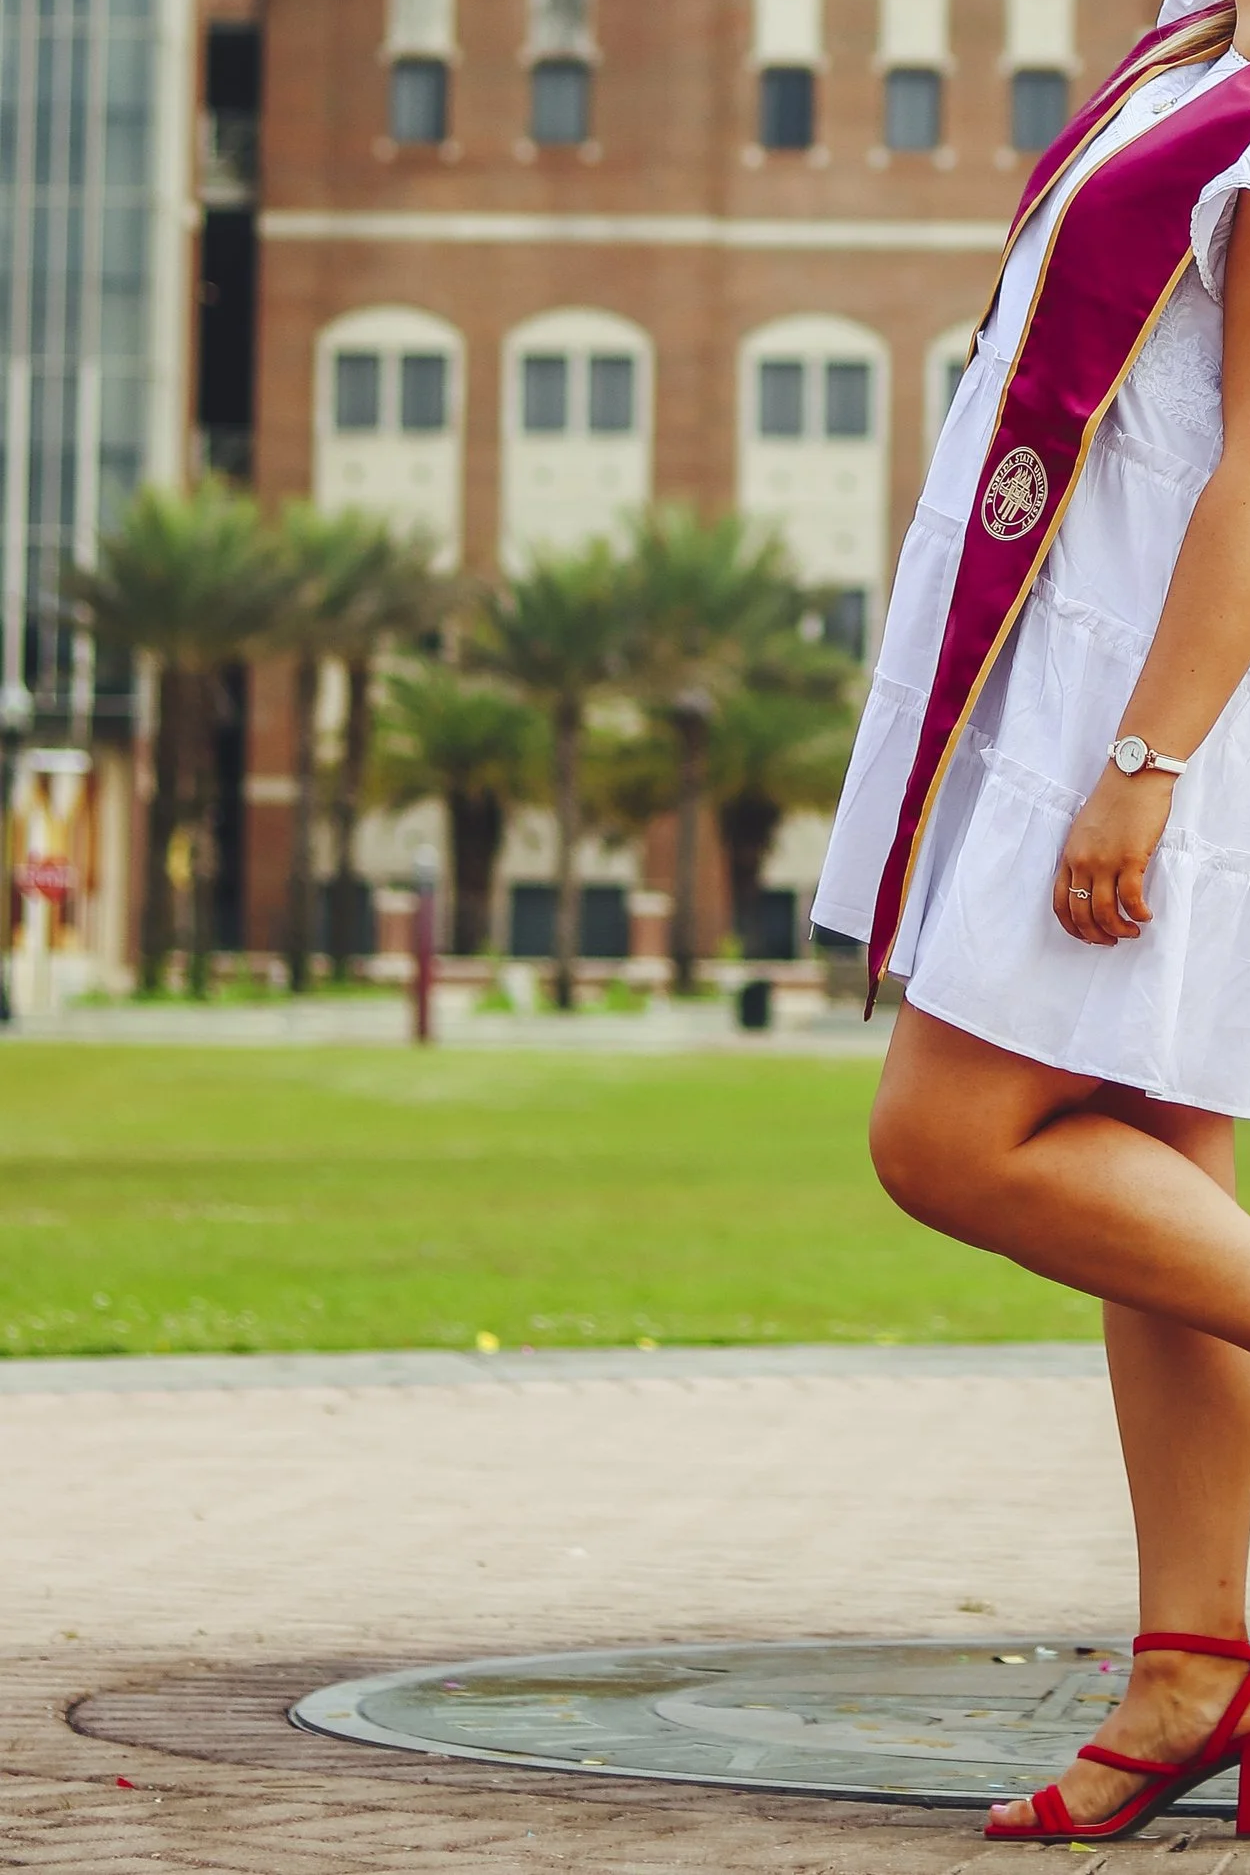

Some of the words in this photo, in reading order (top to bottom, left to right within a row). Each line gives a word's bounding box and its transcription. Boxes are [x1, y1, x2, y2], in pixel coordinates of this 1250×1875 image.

[1015, 453, 1034, 466] STATE
[987, 459, 1013, 504] FLORIDA
[1022, 465, 1043, 529] UNIVERSITY
[990, 519, 1006, 535] 1851
